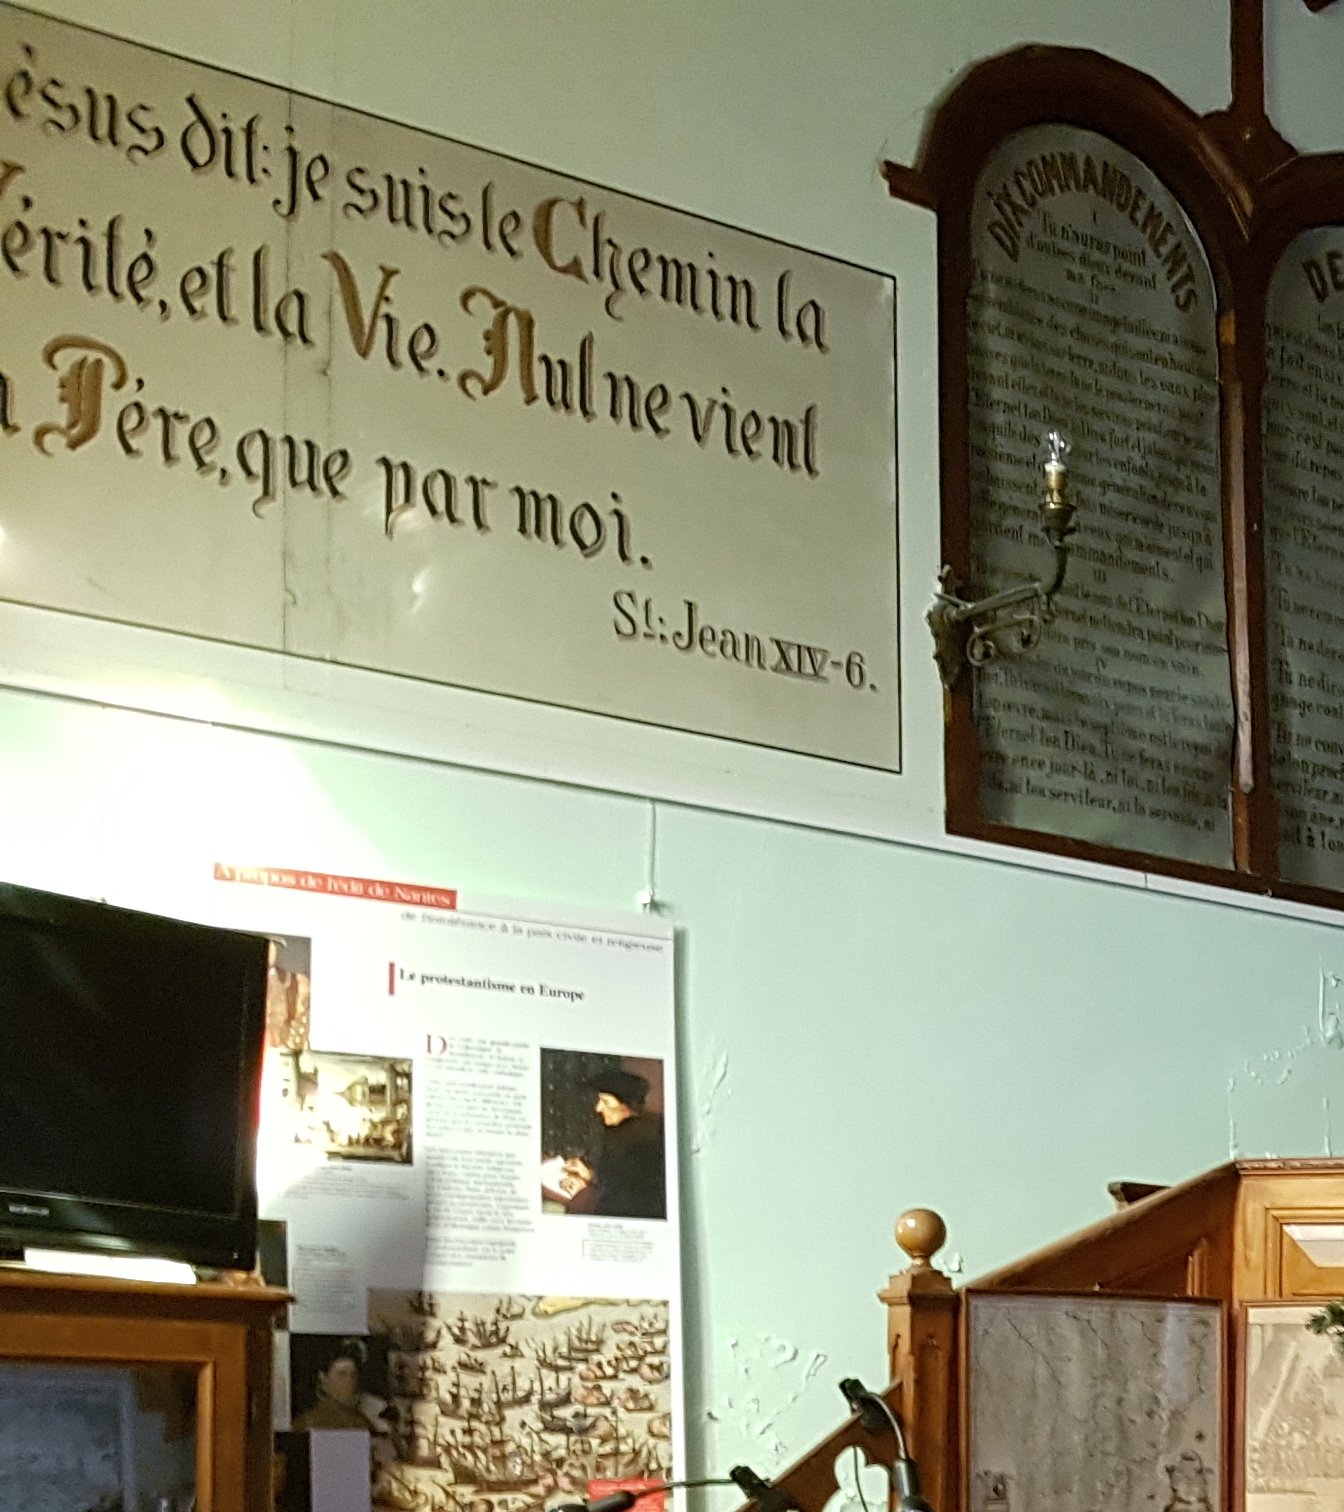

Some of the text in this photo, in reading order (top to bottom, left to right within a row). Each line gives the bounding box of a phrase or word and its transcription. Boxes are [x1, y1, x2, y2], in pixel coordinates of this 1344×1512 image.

[272, 124, 331, 217] je
[345, 167, 471, 246] suis
[480, 183, 523, 259] le
[533, 196, 761, 331] Chemin
[775, 268, 833, 354] la
[1013, 151, 1198, 314] COMMANDEMENTS
[180, 246, 238, 325] et
[252, 244, 317, 348] la
[321, 248, 450, 382] Vie.
[607, 370, 668, 441] ne
[679, 388, 822, 479] vient
[236, 427, 353, 519] que
[376, 453, 510, 540] par
[512, 486, 655, 572] moi.
[671, 598, 766, 671] Jean
[300, 873, 322, 890] de
[367, 881, 390, 898] de
[394, 885, 452, 907] Nantes
[400, 967, 586, 1003] Le protestantisme en Europe
